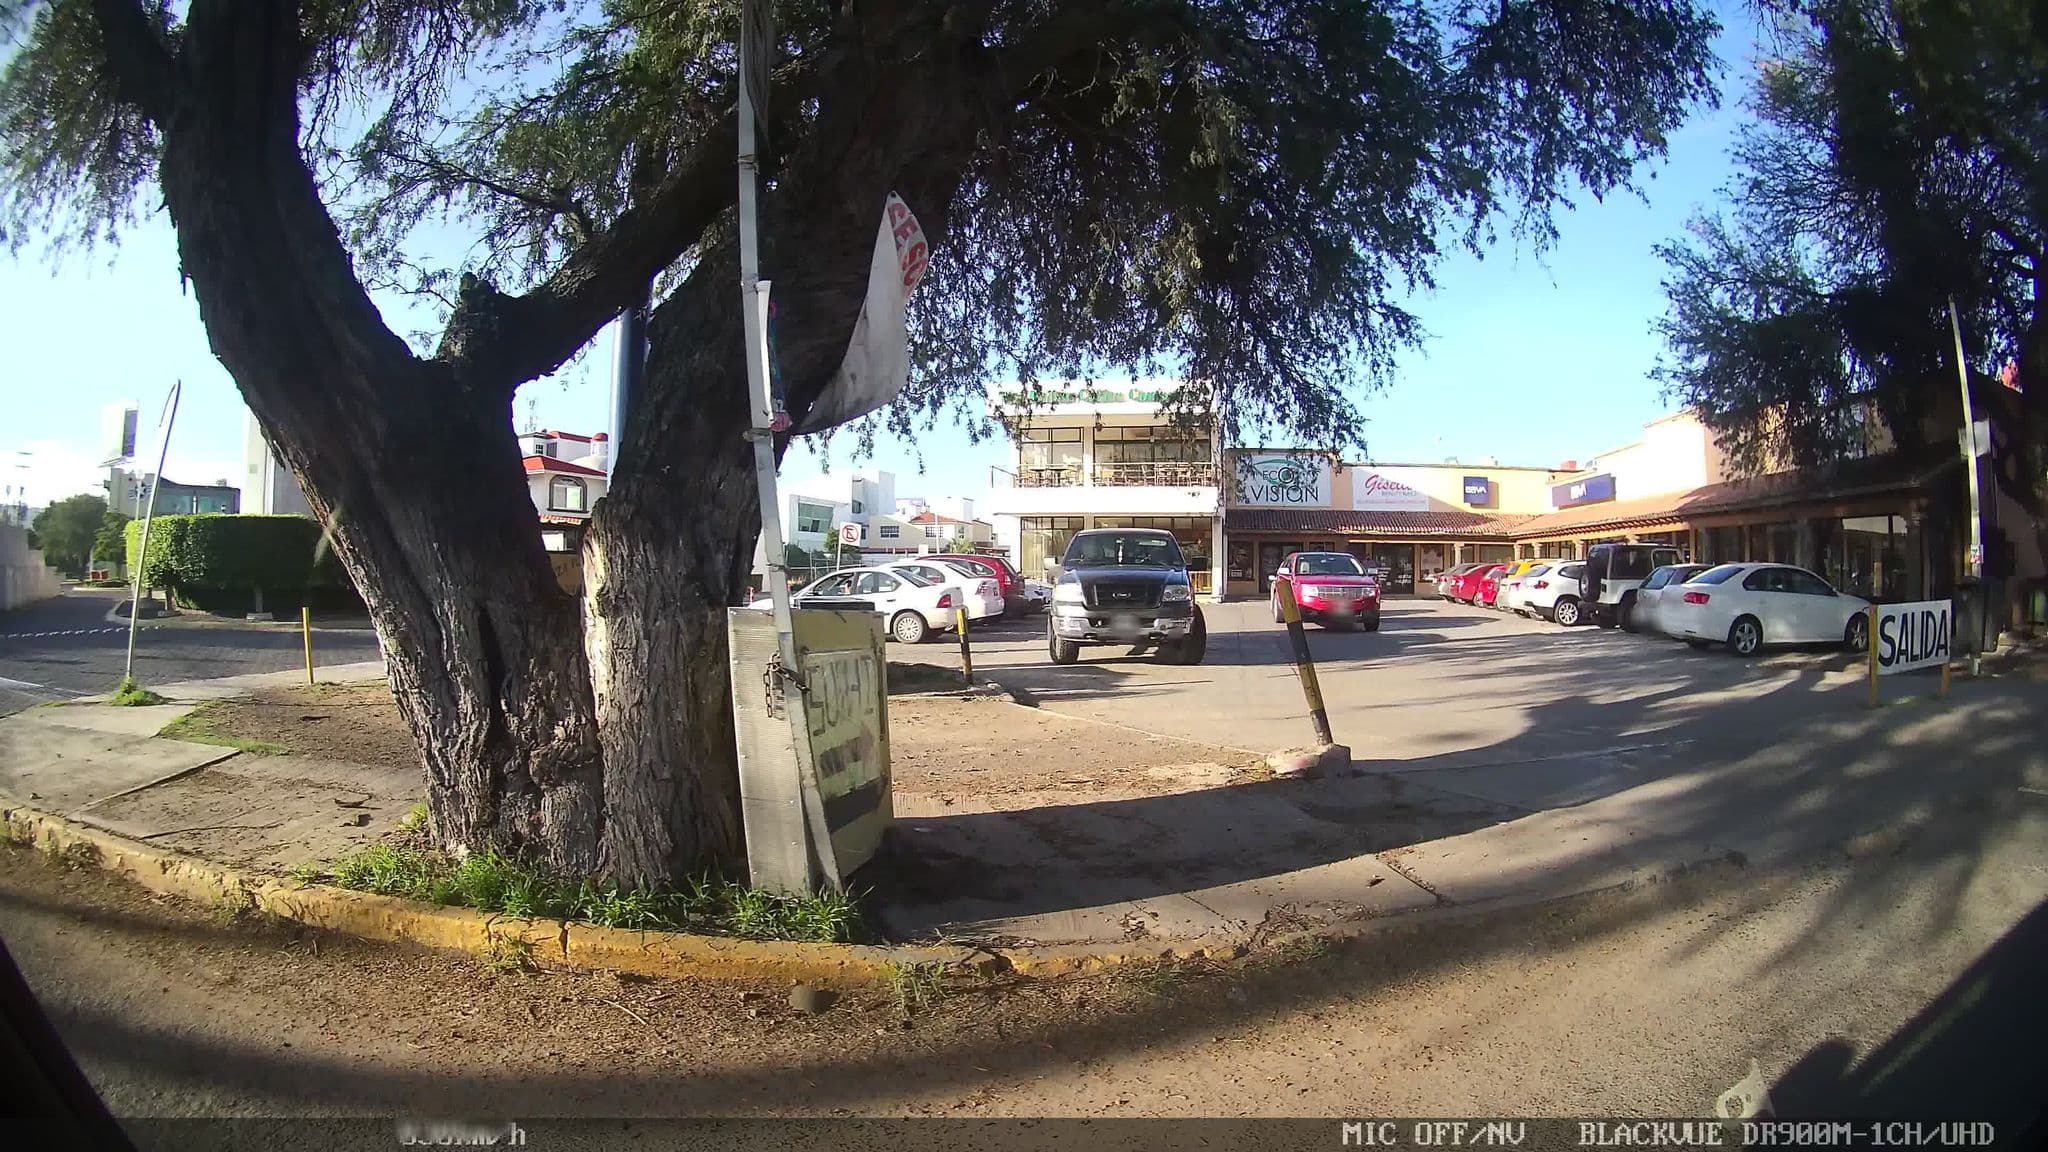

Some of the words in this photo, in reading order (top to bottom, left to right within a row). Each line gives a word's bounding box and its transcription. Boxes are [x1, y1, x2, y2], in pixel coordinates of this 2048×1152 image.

[1262, 467, 1295, 484] ECO
[1250, 485, 1319, 503] VISION
[1465, 485, 1487, 494] BBVA
[1878, 610, 1949, 668] SALIDA
